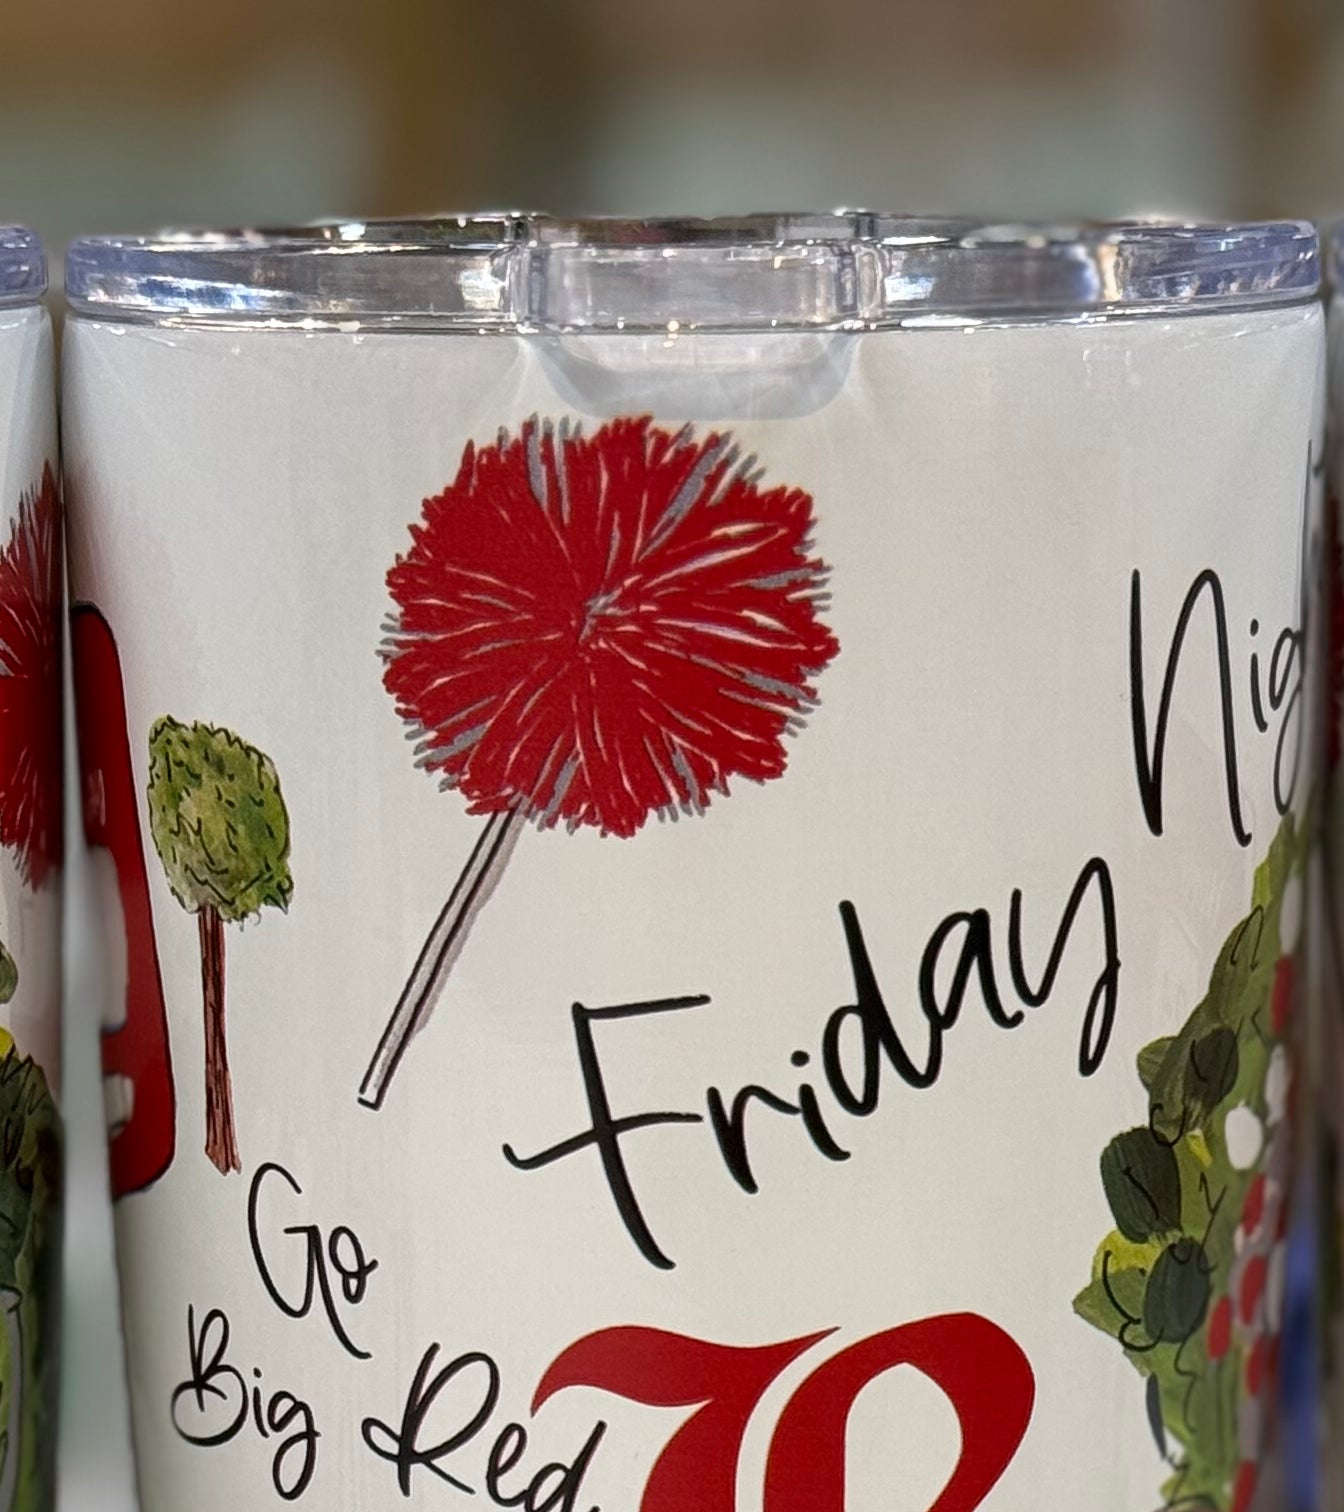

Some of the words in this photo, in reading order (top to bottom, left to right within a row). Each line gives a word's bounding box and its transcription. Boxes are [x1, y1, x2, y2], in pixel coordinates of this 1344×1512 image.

[1129, 567, 1304, 848] Nig
[502, 856, 1121, 1271] Friday
[247, 1161, 379, 1358] Go
[170, 1306, 320, 1501] Big
